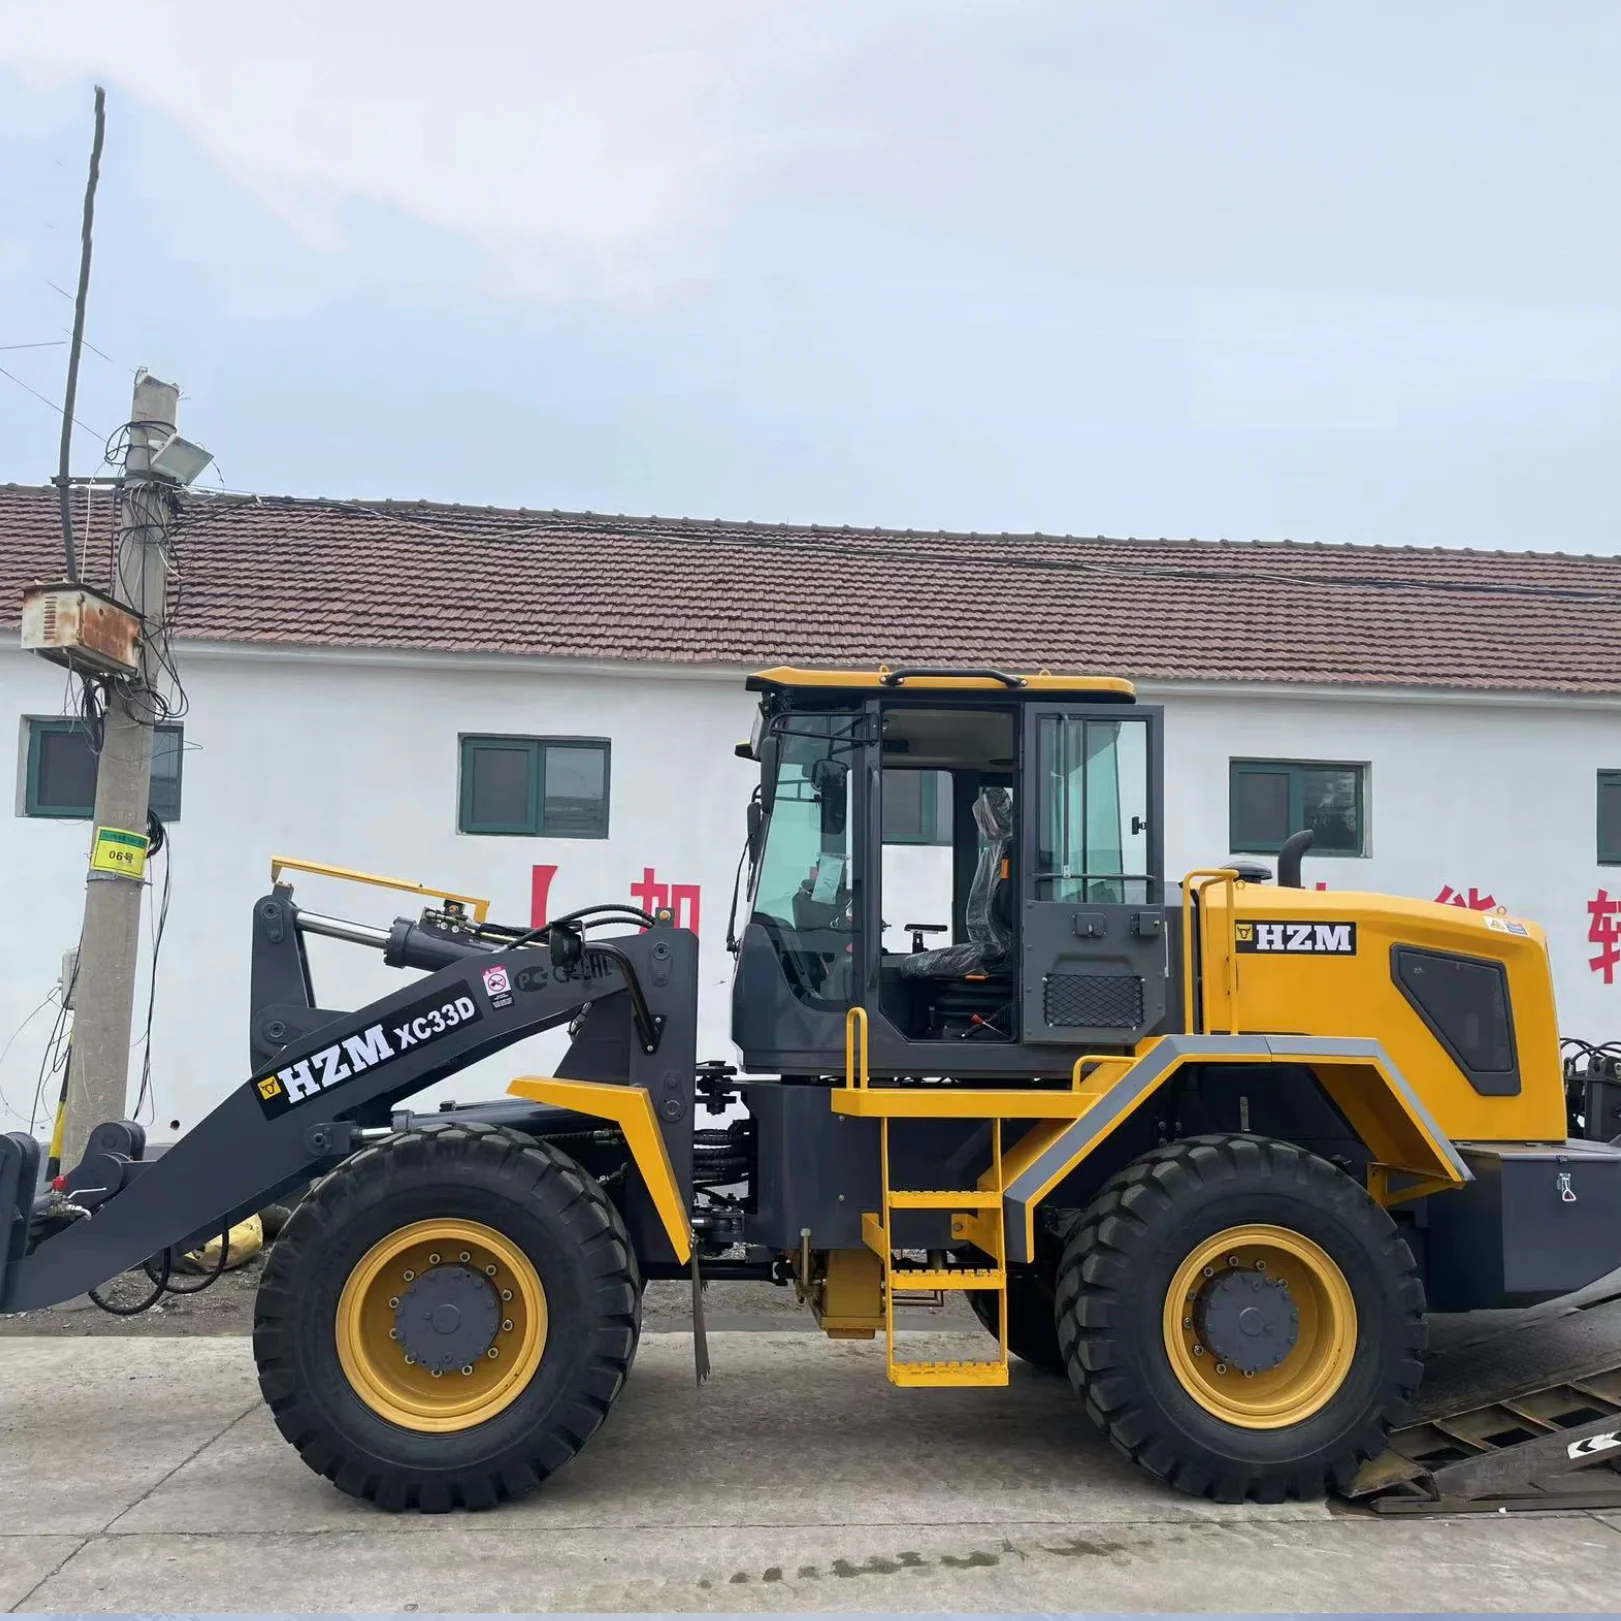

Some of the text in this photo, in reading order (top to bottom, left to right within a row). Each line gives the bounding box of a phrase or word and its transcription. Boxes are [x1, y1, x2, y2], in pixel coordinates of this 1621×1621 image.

[109, 850, 134, 864] 06号
[1256, 924, 1351, 951] HZM
[277, 996, 475, 1104] HZM XC33D
